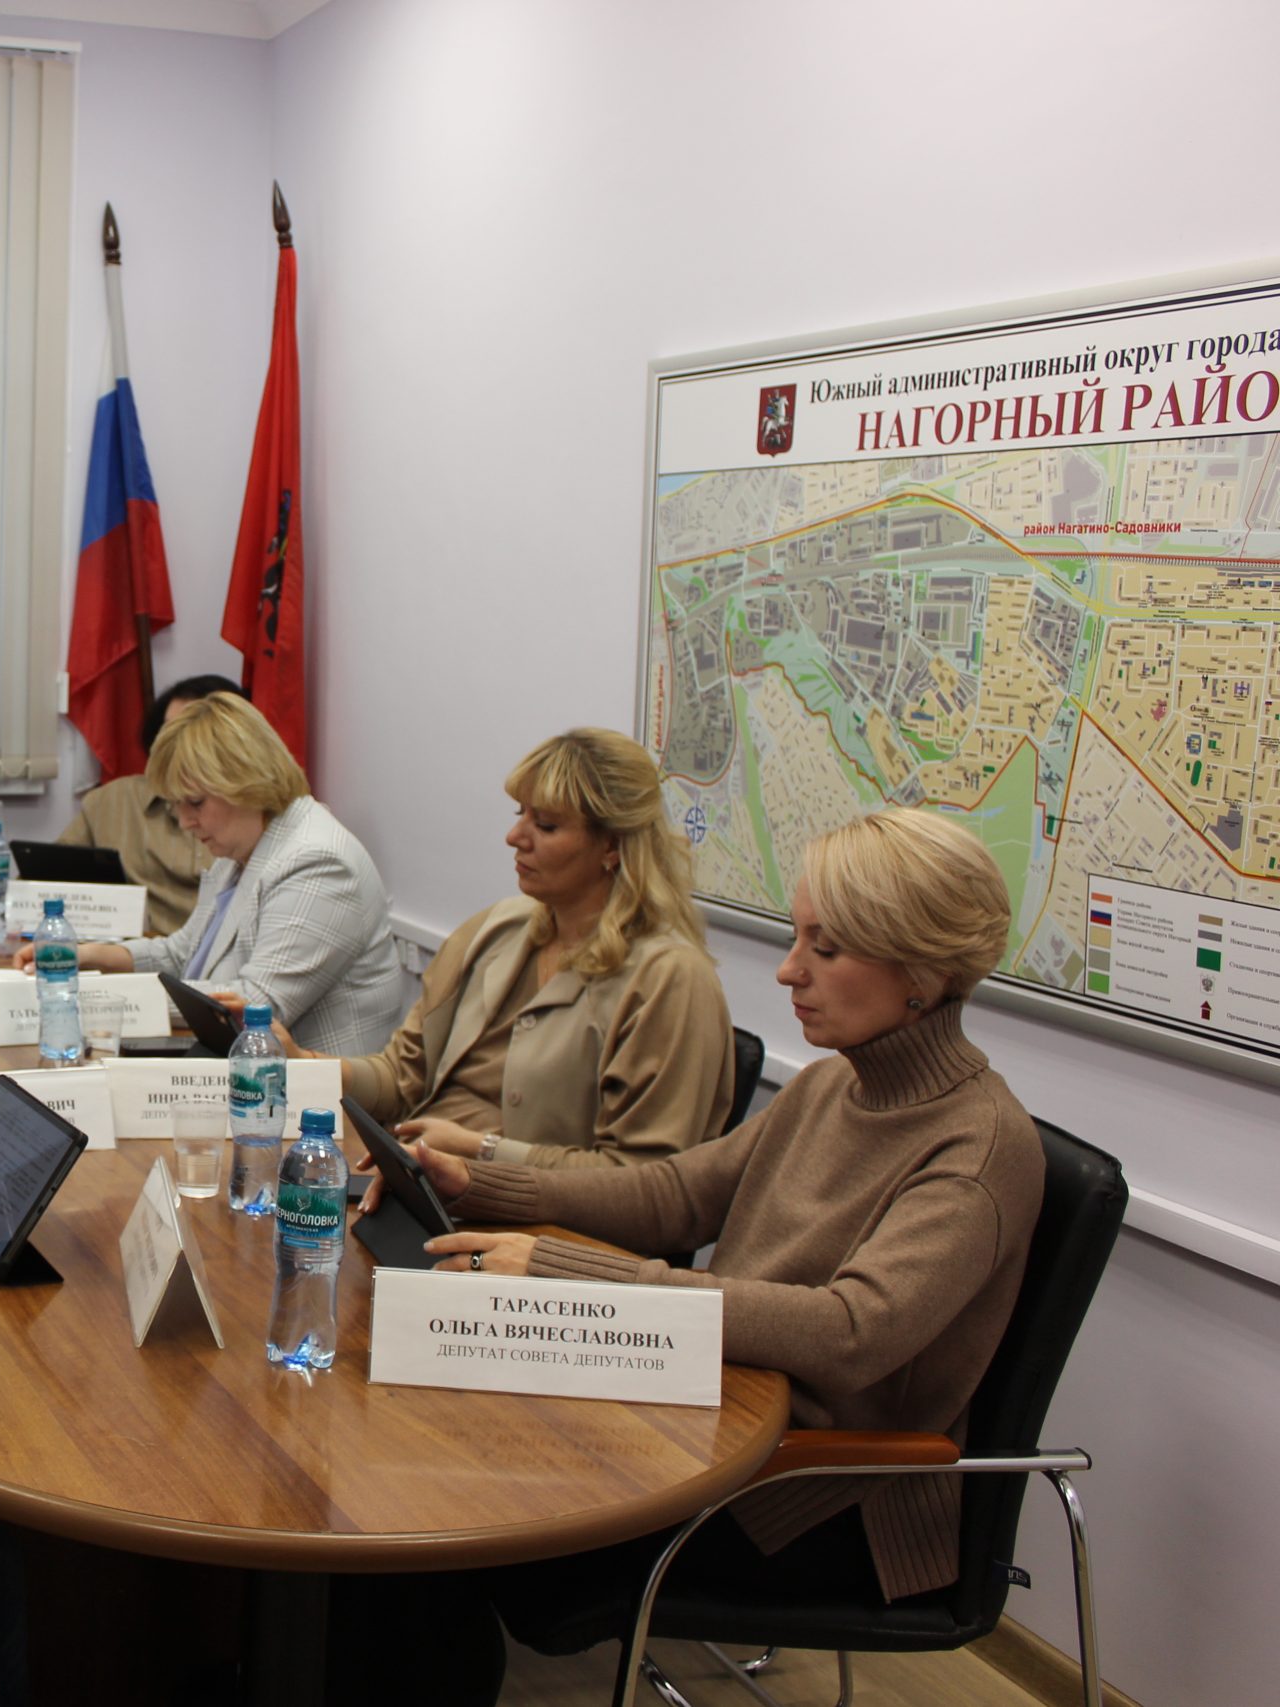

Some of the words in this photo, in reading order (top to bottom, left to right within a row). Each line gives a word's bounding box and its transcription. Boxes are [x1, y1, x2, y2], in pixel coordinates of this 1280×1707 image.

[810, 374, 883, 404] Южный
[888, 345, 1097, 396] административный
[1105, 339, 1180, 378] округ
[1186, 327, 1280, 366] города
[857, 376, 1109, 452] НАГОРНЫЙ
[1024, 522, 1056, 537] район
[1058, 520, 1182, 535] Нагатино-Садовники
[171, 1075, 227, 1087] ВВЕДЕН
[489, 1296, 617, 1320] ТАРАСЕНКО
[429, 1318, 498, 1338] ОЛЬГА
[505, 1323, 675, 1350] ВЯЧЕСЛАВОВНА
[436, 1343, 508, 1361] ДЕПУТАТ
[509, 1349, 570, 1366] СОВЕТА
[572, 1353, 666, 1372] ДЕПУТАТОВ
